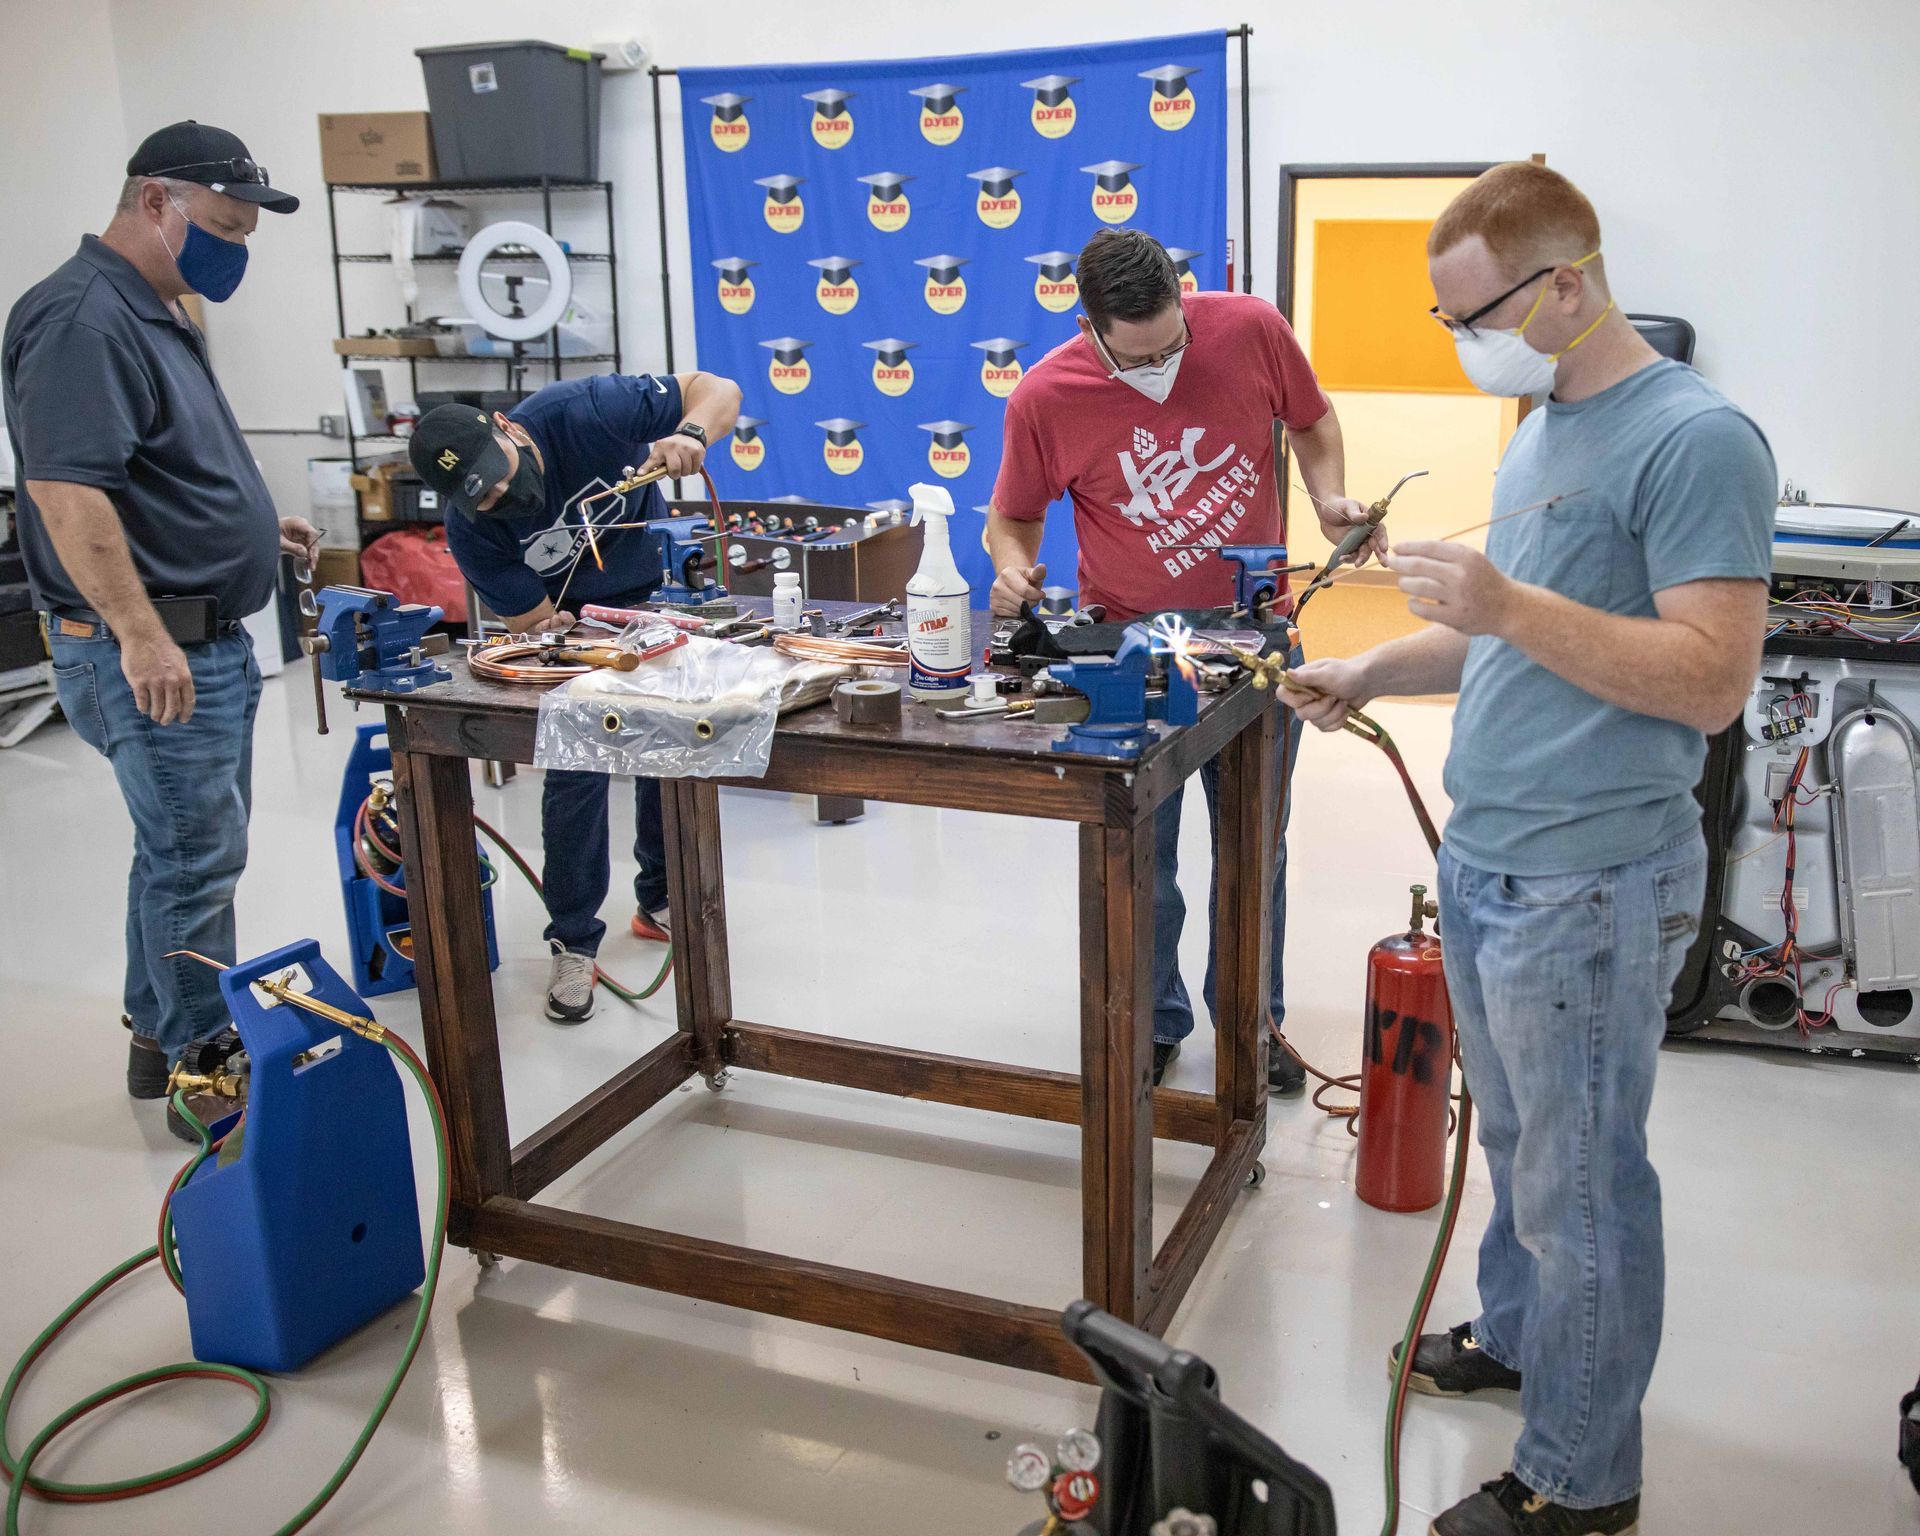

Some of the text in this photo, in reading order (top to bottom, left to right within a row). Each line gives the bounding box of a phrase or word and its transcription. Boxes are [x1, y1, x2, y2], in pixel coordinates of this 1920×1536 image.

[1153, 99, 1192, 113] DYER
[1035, 107, 1073, 121] DYER
[815, 120, 849, 132] DYER
[923, 116, 959, 129] DYER
[715, 124, 747, 135] DYER
[1095, 193, 1134, 206] DYER
[767, 206, 801, 216] DYER
[871, 203, 907, 215] DYER
[981, 199, 1017, 212] DYER
[721, 287, 751, 298] DYER
[821, 287, 855, 297] DYER
[929, 286, 963, 297] DYER
[1039, 283, 1075, 295] DYER
[773, 367, 807, 378] DYER
[876, 369, 909, 380] DYER
[985, 370, 1019, 380] DYER
[827, 448, 860, 459] DYER
[932, 451, 966, 461] DYER
[1146, 454, 1254, 554] HEMISPHERE
[1163, 500, 1246, 578] BREWING
